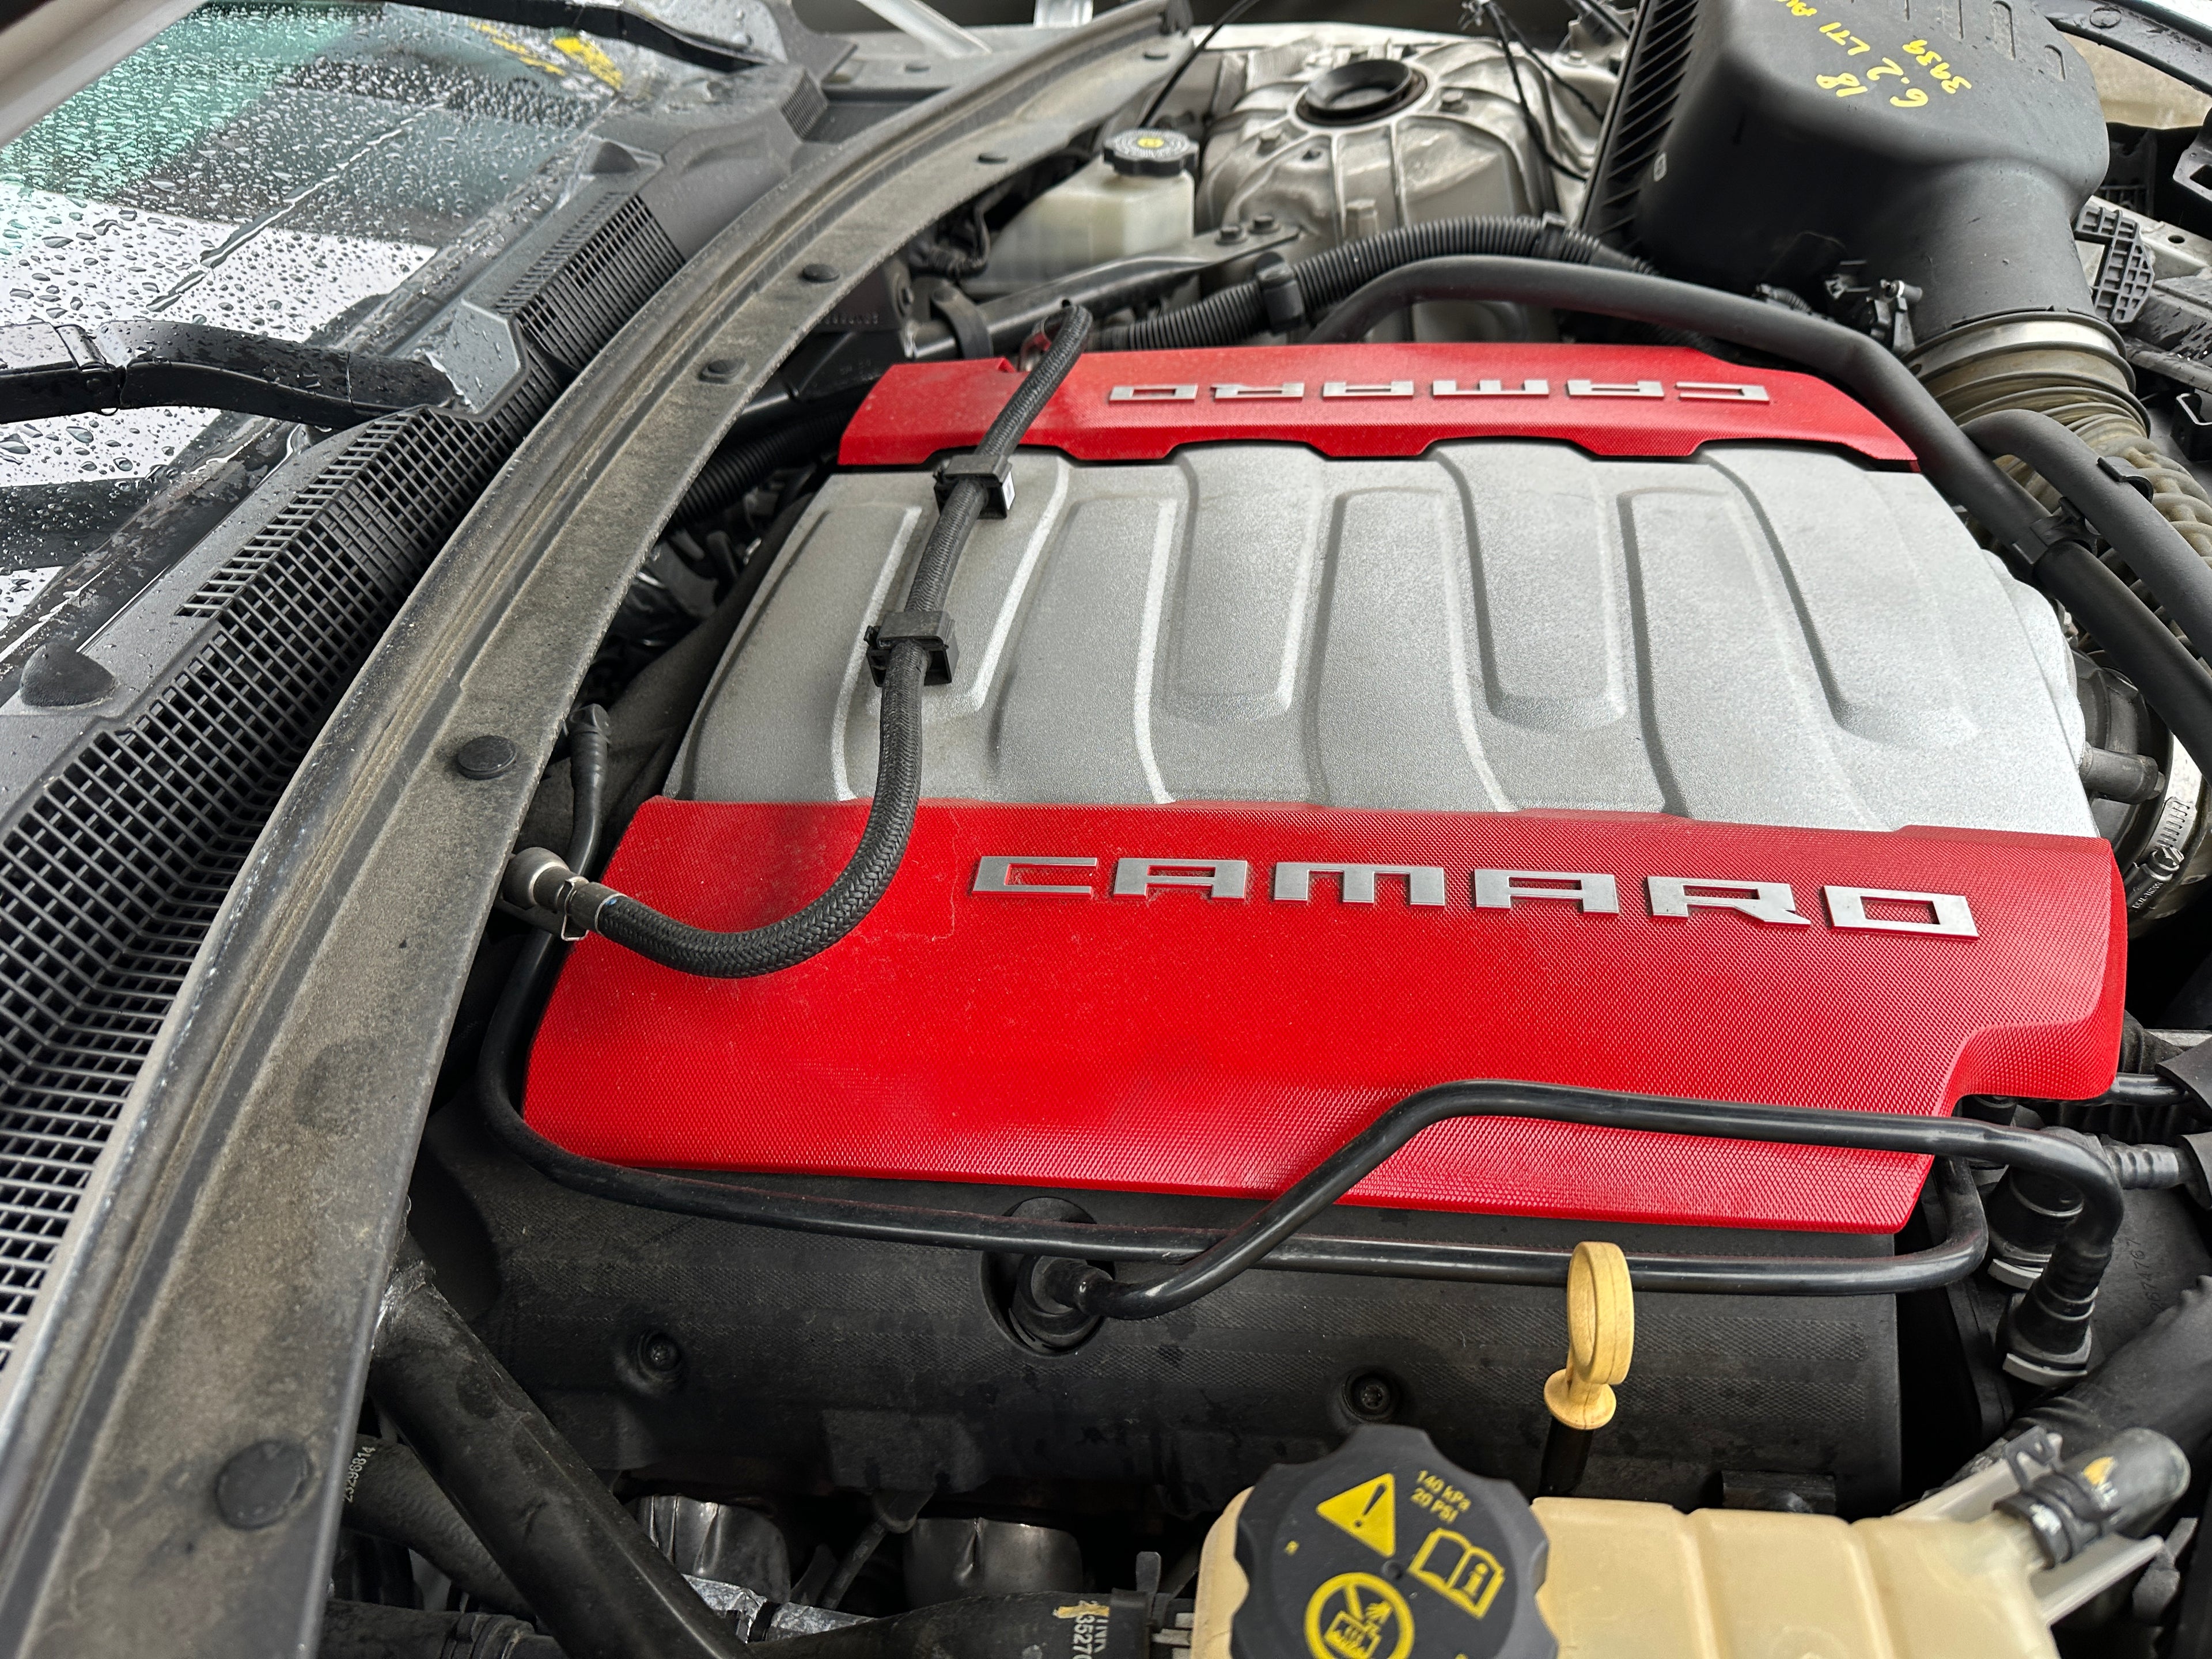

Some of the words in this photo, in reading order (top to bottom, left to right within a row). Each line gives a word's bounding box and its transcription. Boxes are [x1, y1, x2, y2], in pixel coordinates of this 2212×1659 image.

[1816, 73, 1867, 97] 18
[1867, 58, 1928, 107] 6.2
[1903, 39, 1972, 93] 3939
[1108, 378, 1769, 402] CAMARO
[973, 856, 1980, 939] CAMARO
[1411, 1487, 1433, 1508] 20
[1431, 1500, 1459, 1524] PSI
[1416, 1470, 1445, 1493] 140
[1442, 1486, 1471, 1512] kPa
